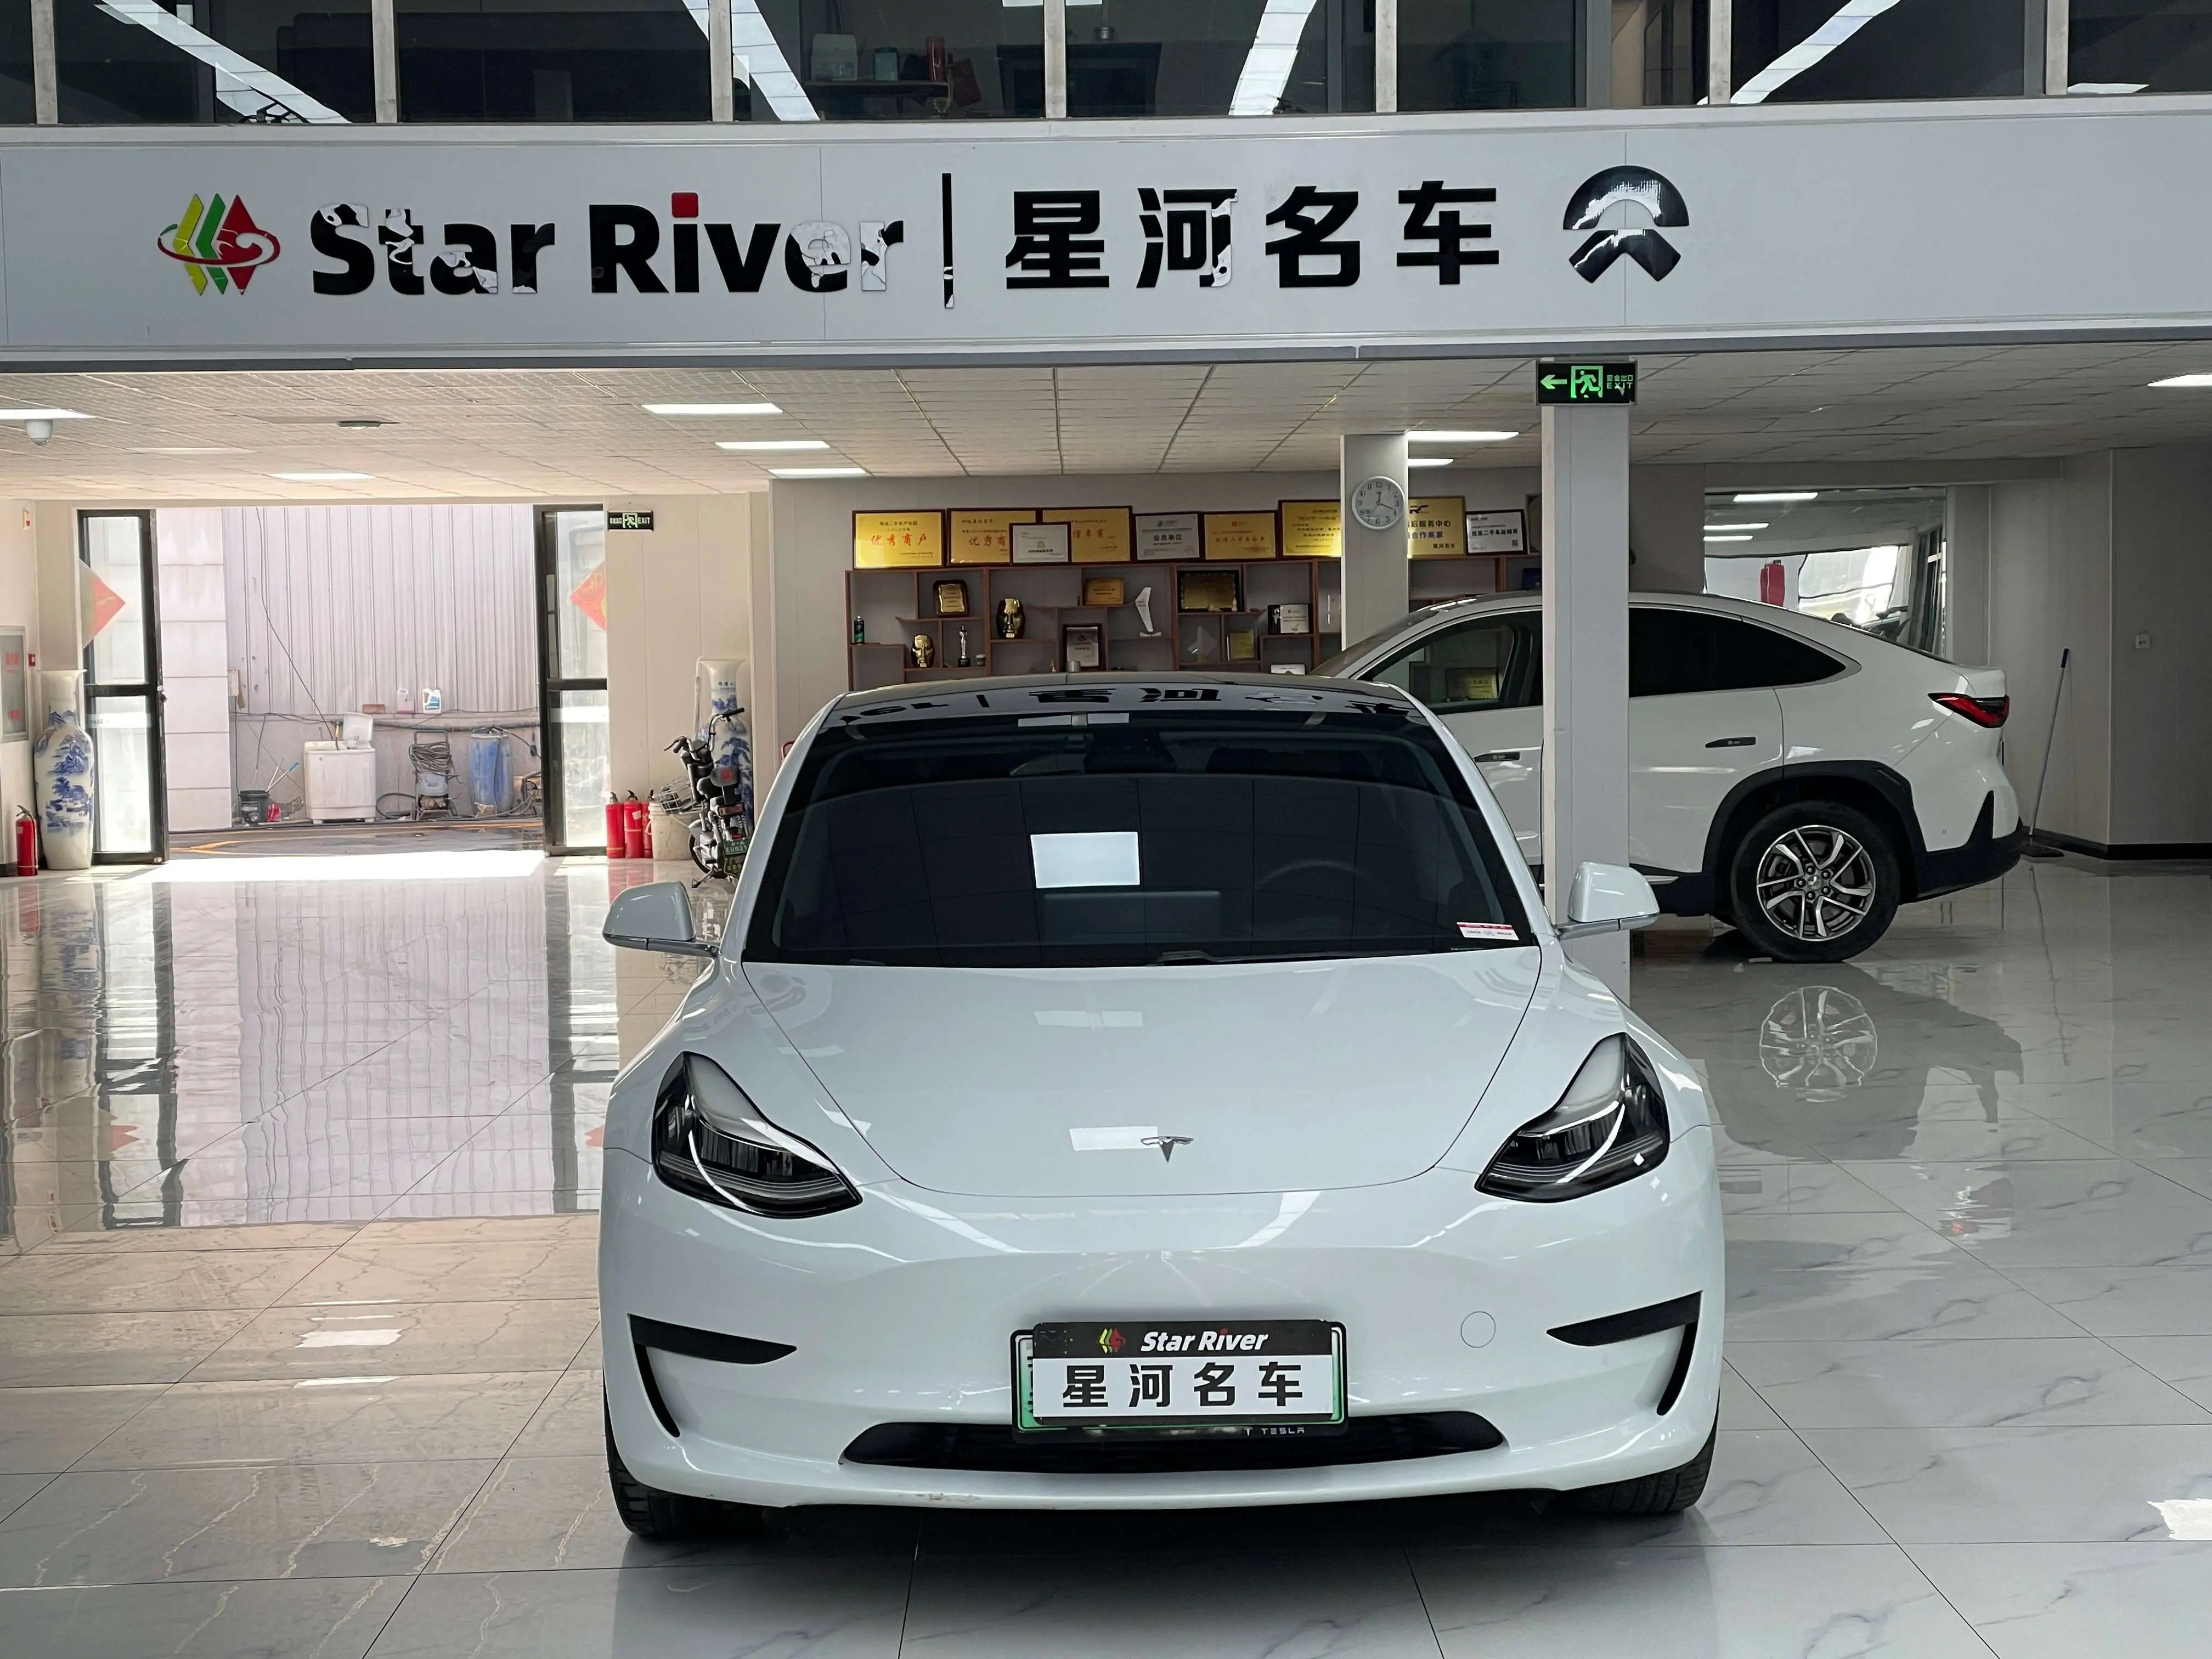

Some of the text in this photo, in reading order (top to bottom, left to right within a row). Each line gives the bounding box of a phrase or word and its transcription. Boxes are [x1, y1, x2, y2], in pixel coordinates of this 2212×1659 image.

[312, 191, 904, 295] Star River
[1006, 180, 1500, 290] 星河名车
[871, 533, 927, 546] 优秀商户
[1141, 1328, 1268, 1352] Star River
[1063, 1362, 1303, 1408] 星河名车
[1261, 1427, 1305, 1435] TESLA
